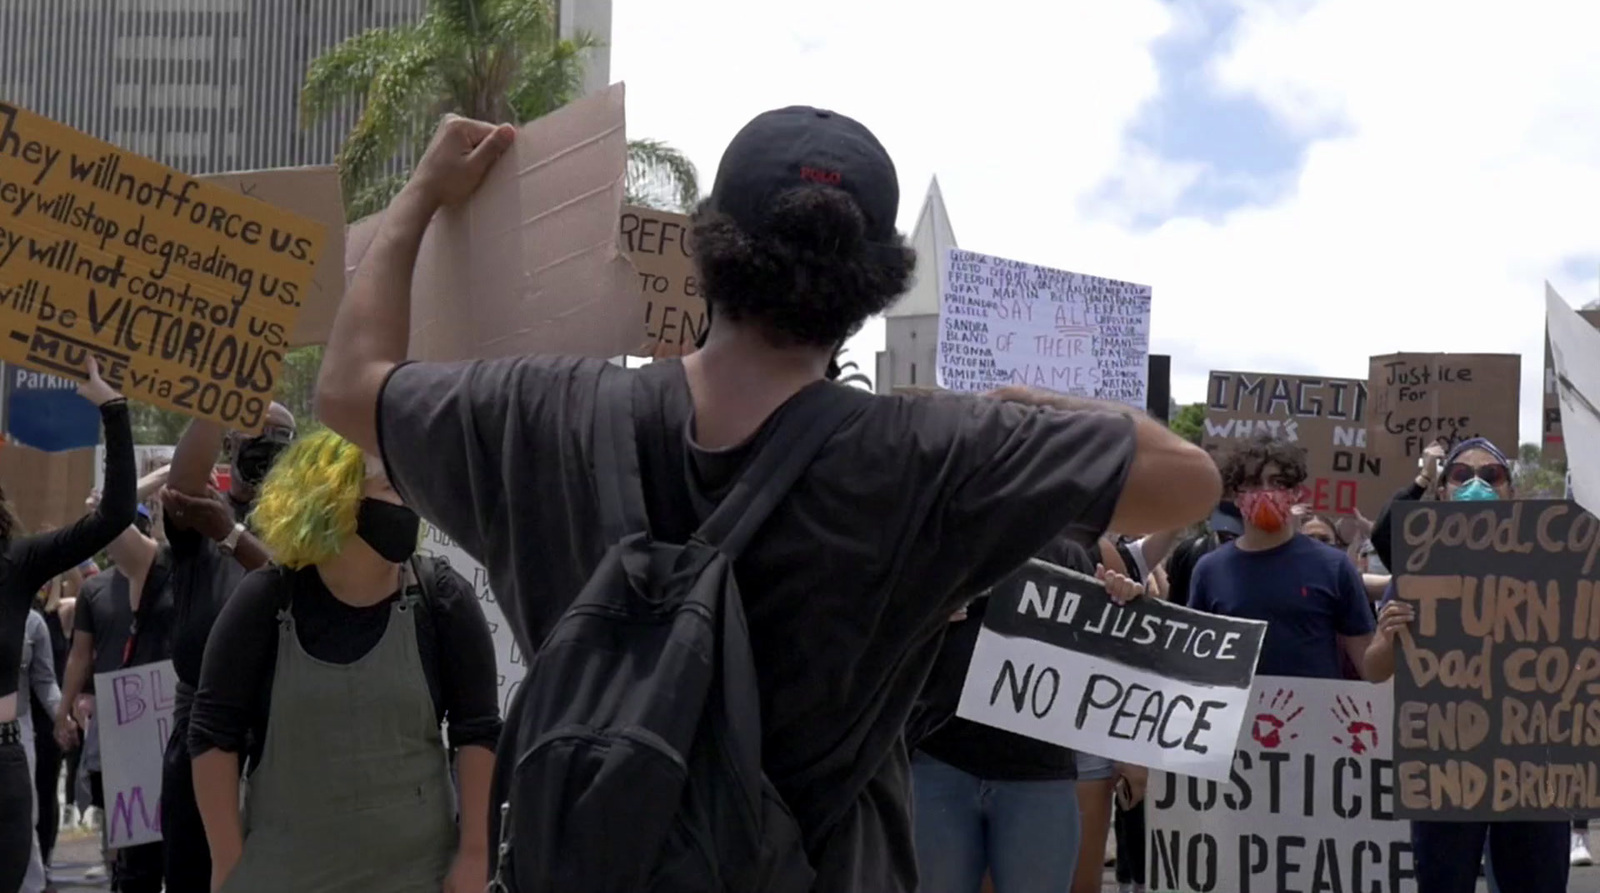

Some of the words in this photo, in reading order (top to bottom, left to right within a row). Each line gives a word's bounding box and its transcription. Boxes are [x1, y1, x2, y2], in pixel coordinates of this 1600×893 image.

[70, 152, 120, 192] will
[116, 173, 180, 211] not
[270, 229, 315, 265] us.
[37, 192, 76, 224] will
[71, 201, 118, 250] stop
[260, 274, 300, 307] us.
[29, 238, 77, 275] will
[76, 255, 128, 289] not
[249, 315, 288, 348] us.
[639, 272, 669, 293] TO
[38, 287, 77, 330] be
[88, 288, 281, 393] VICTORIOUS
[998, 300, 1034, 322] SAY
[1055, 305, 1097, 328] ALL
[996, 332, 1017, 352] OF
[1034, 334, 1085, 358] THEIR
[1383, 361, 1473, 386] Justice
[131, 370, 173, 399] via
[172, 376, 264, 429] 2009
[1010, 364, 1100, 388] NAMES
[1399, 386, 1427, 402] For
[1332, 451, 1381, 477] ON
[1403, 502, 1534, 572] good
[1017, 580, 1081, 624] NO
[1084, 603, 1240, 660] JUSTICE
[1397, 574, 1560, 643] TURN
[1399, 624, 1494, 700] bad
[989, 659, 1060, 719] NO
[1075, 673, 1228, 754] PEACE
[1399, 700, 1490, 751] END
[1399, 757, 1488, 811] END
[1150, 828, 1217, 892] NO
